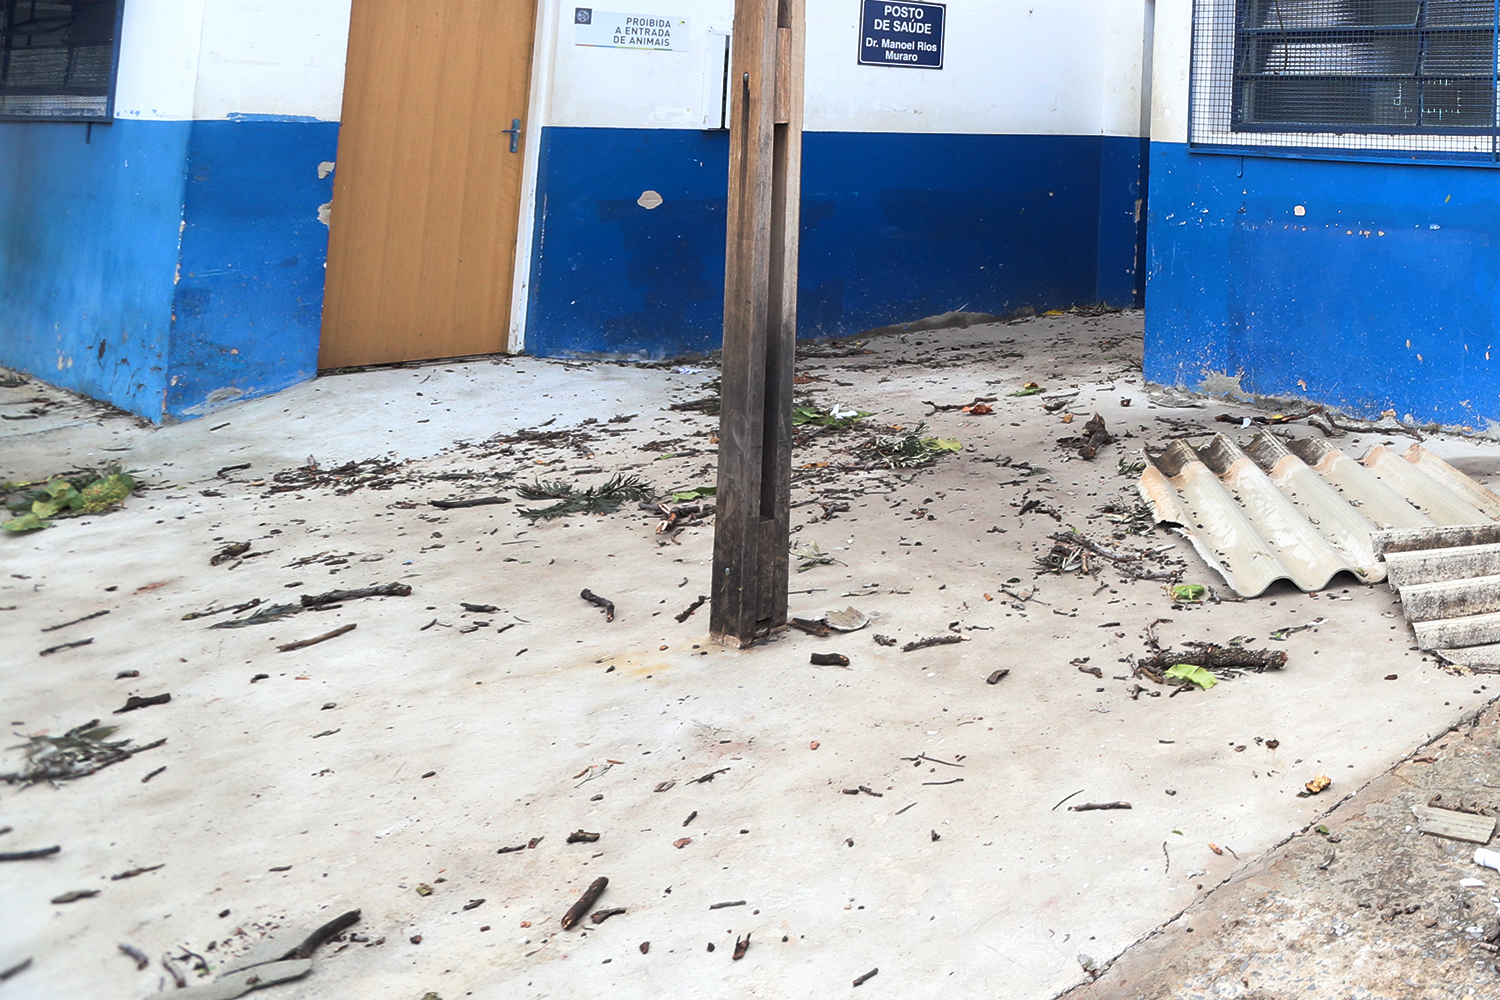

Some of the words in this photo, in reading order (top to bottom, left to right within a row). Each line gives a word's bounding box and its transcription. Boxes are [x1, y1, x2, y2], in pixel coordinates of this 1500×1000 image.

[884, 4, 924, 20] POSTO
[626, 16, 672, 28] PROIBIDA
[874, 18, 891, 31] DE
[892, 18, 932, 35] SAÚDE
[615, 26, 621, 34] A
[625, 26, 671, 37] ENTRADA
[613, 35, 626, 44] DE
[629, 36, 670, 47] ANIMAIS
[865, 37, 879, 48] Dr.
[881, 38, 915, 50] Manoel
[917, 41, 938, 52] Rios
[885, 50, 918, 62] Muraro
